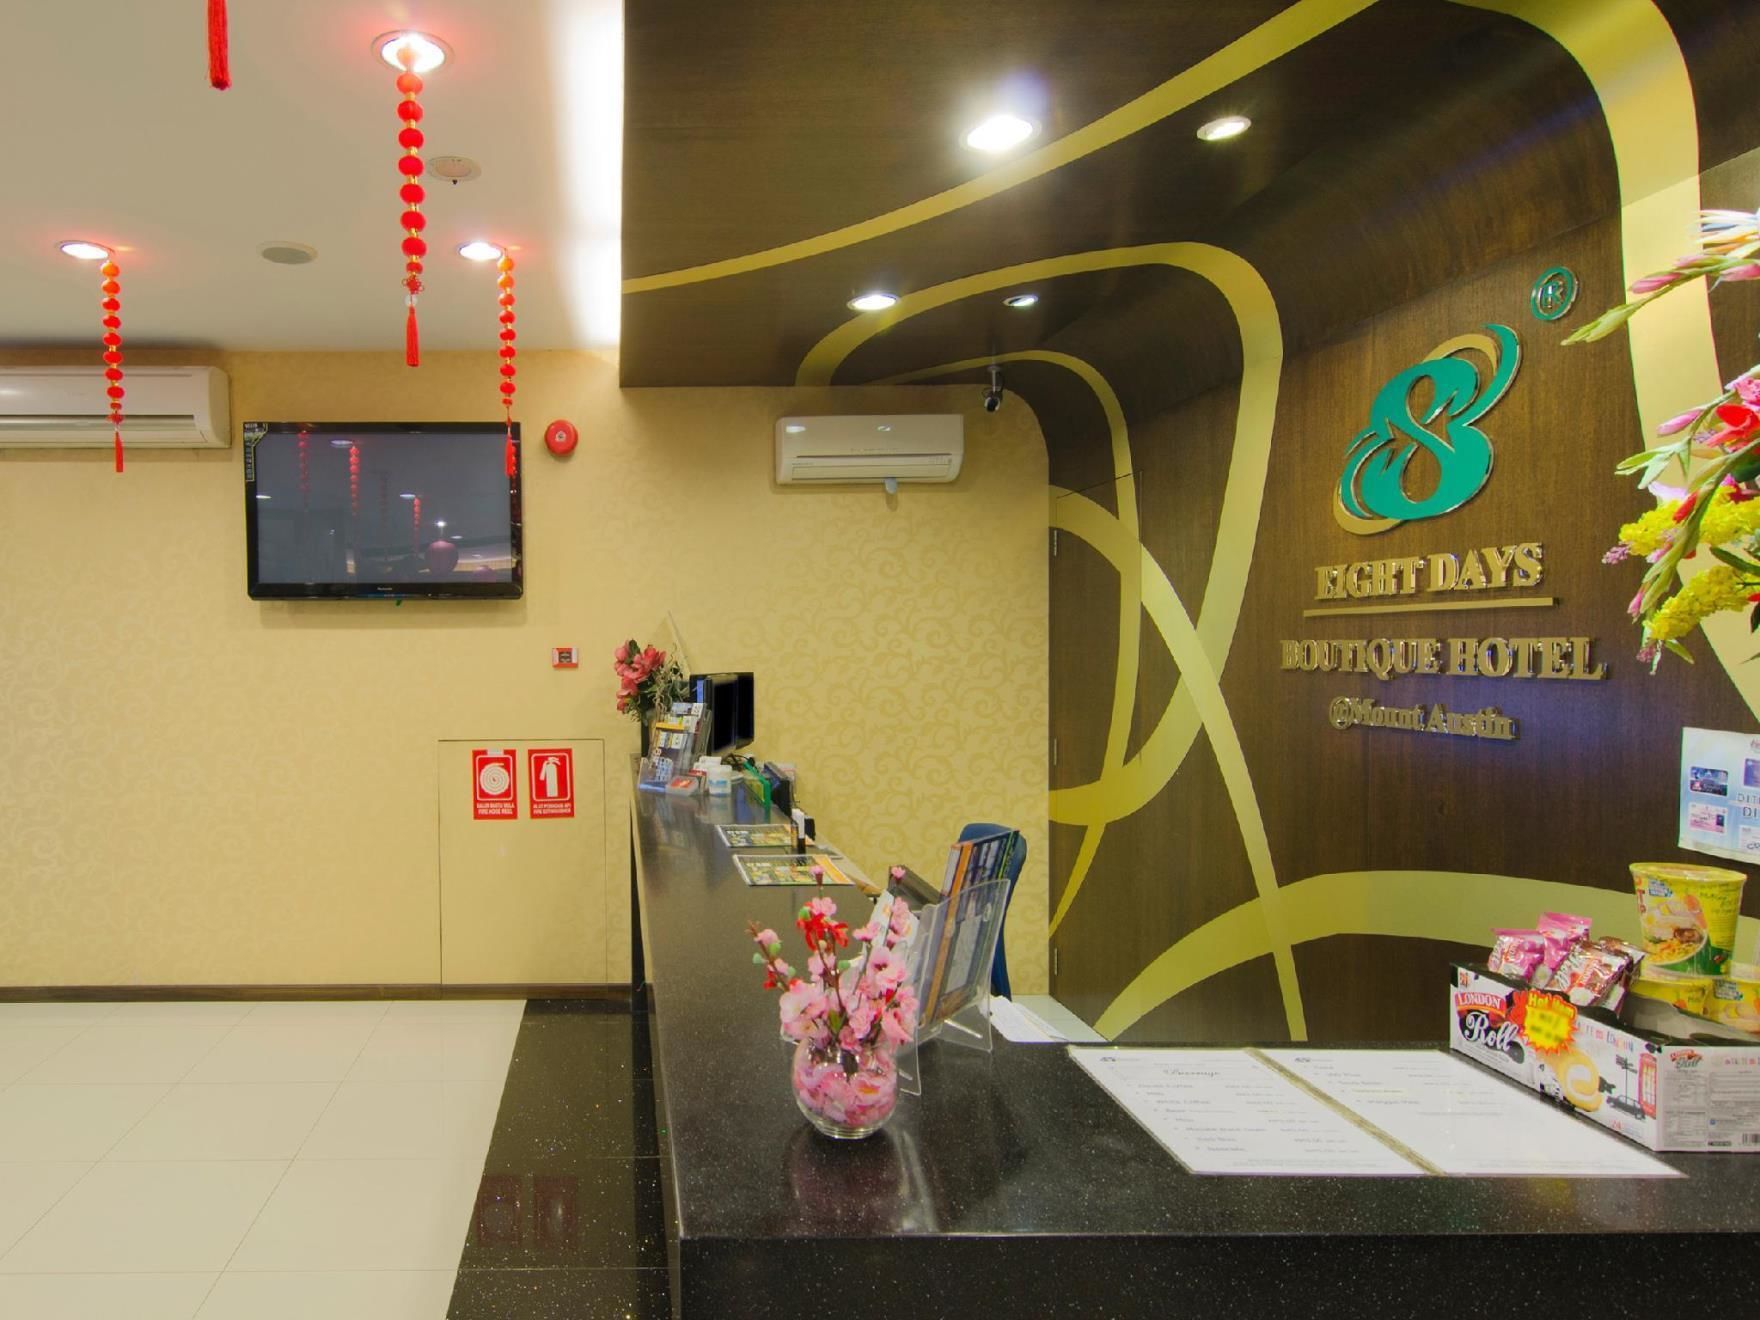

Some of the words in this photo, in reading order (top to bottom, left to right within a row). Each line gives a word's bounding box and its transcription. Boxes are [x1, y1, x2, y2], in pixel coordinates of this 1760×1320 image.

[1314, 557, 1425, 600] EIGHT
[1427, 542, 1544, 592] DAYS
[1280, 637, 1443, 681] BOUTIQUE
[1446, 636, 1609, 682] HOTEL
[1329, 696, 1424, 731] @Mount
[1426, 703, 1519, 741] Austin
[1458, 991, 1501, 1009] LONDON
[1465, 1012, 1518, 1052] Roll
